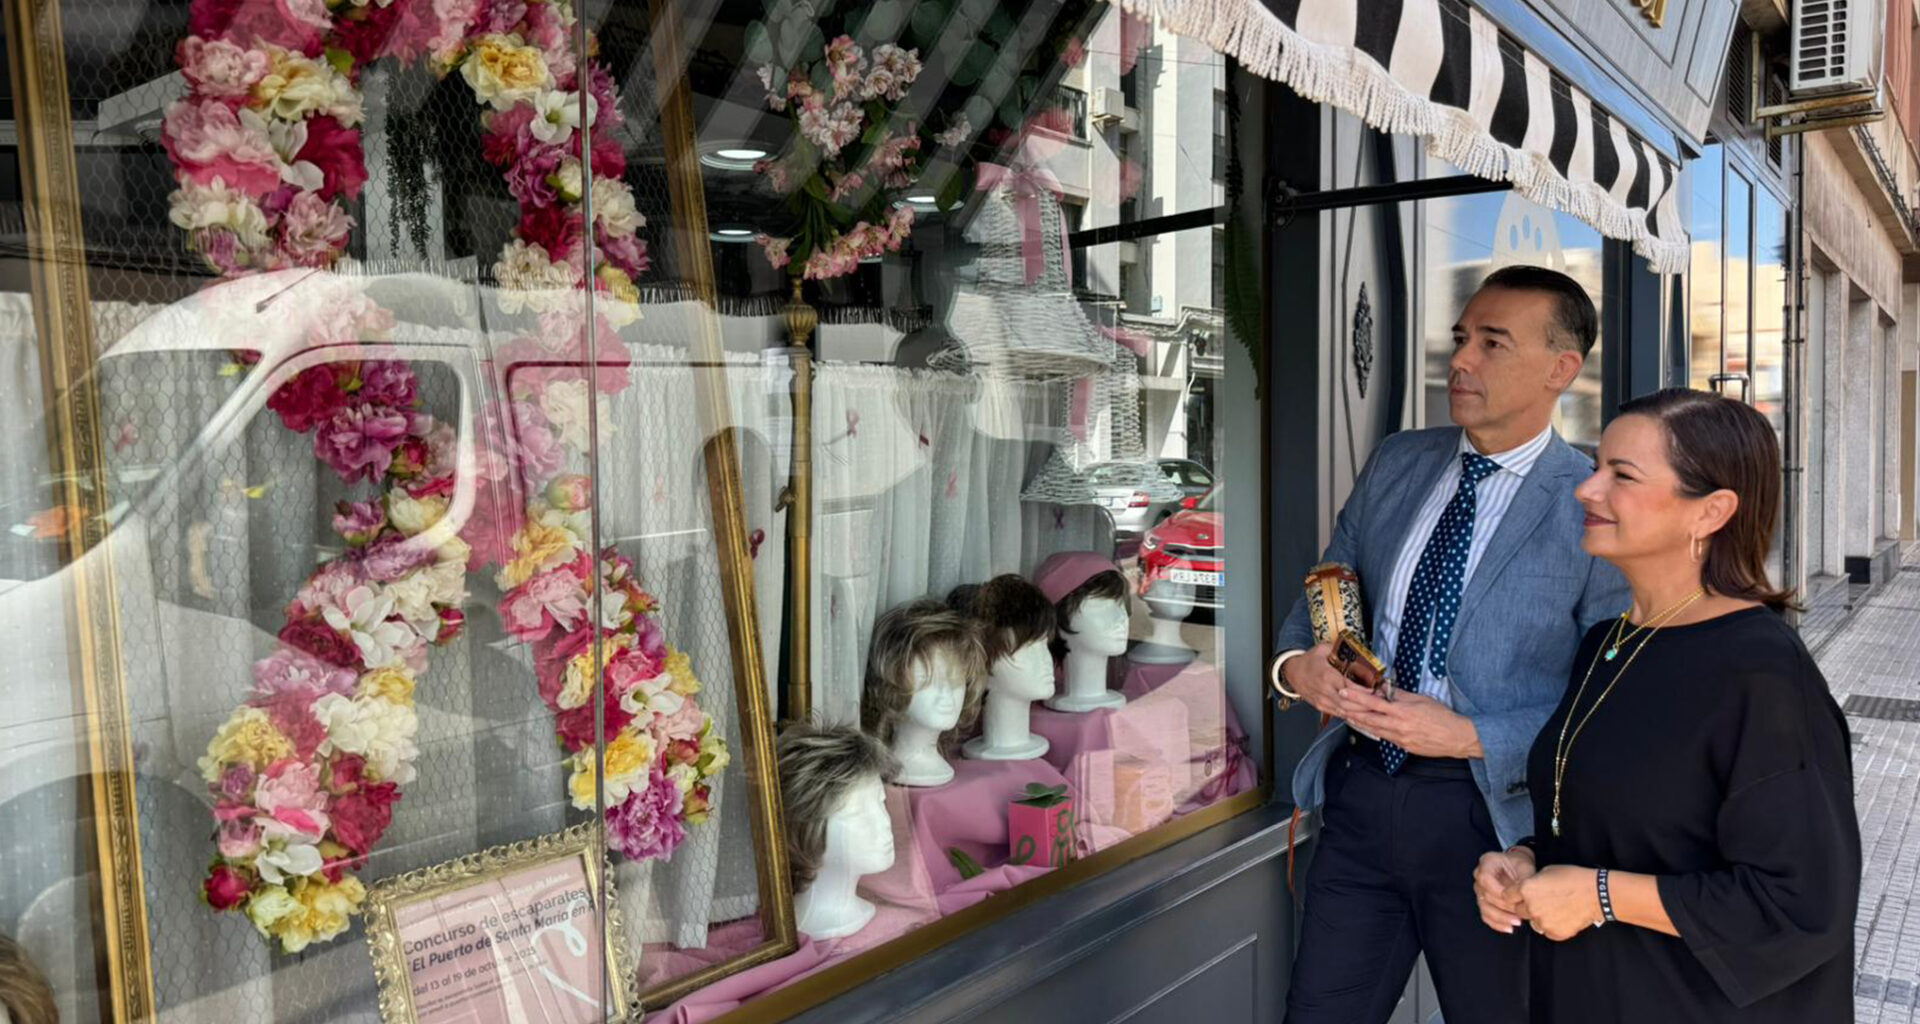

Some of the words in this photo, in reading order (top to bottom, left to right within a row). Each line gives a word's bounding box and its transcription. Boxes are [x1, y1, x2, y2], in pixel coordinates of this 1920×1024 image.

[404, 923, 476, 956] Concurso
[480, 914, 498, 929] de
[502, 888, 587, 921] escaparates
[429, 940, 474, 966] Puerto
[475, 934, 492, 948] de
[495, 923, 531, 943] Santa
[571, 905, 585, 918] en
[413, 983, 429, 997] del
[430, 979, 440, 990] 13
[441, 976, 452, 986] al
[453, 972, 462, 983] 19
[464, 967, 477, 979] de
[479, 953, 513, 974] octure
